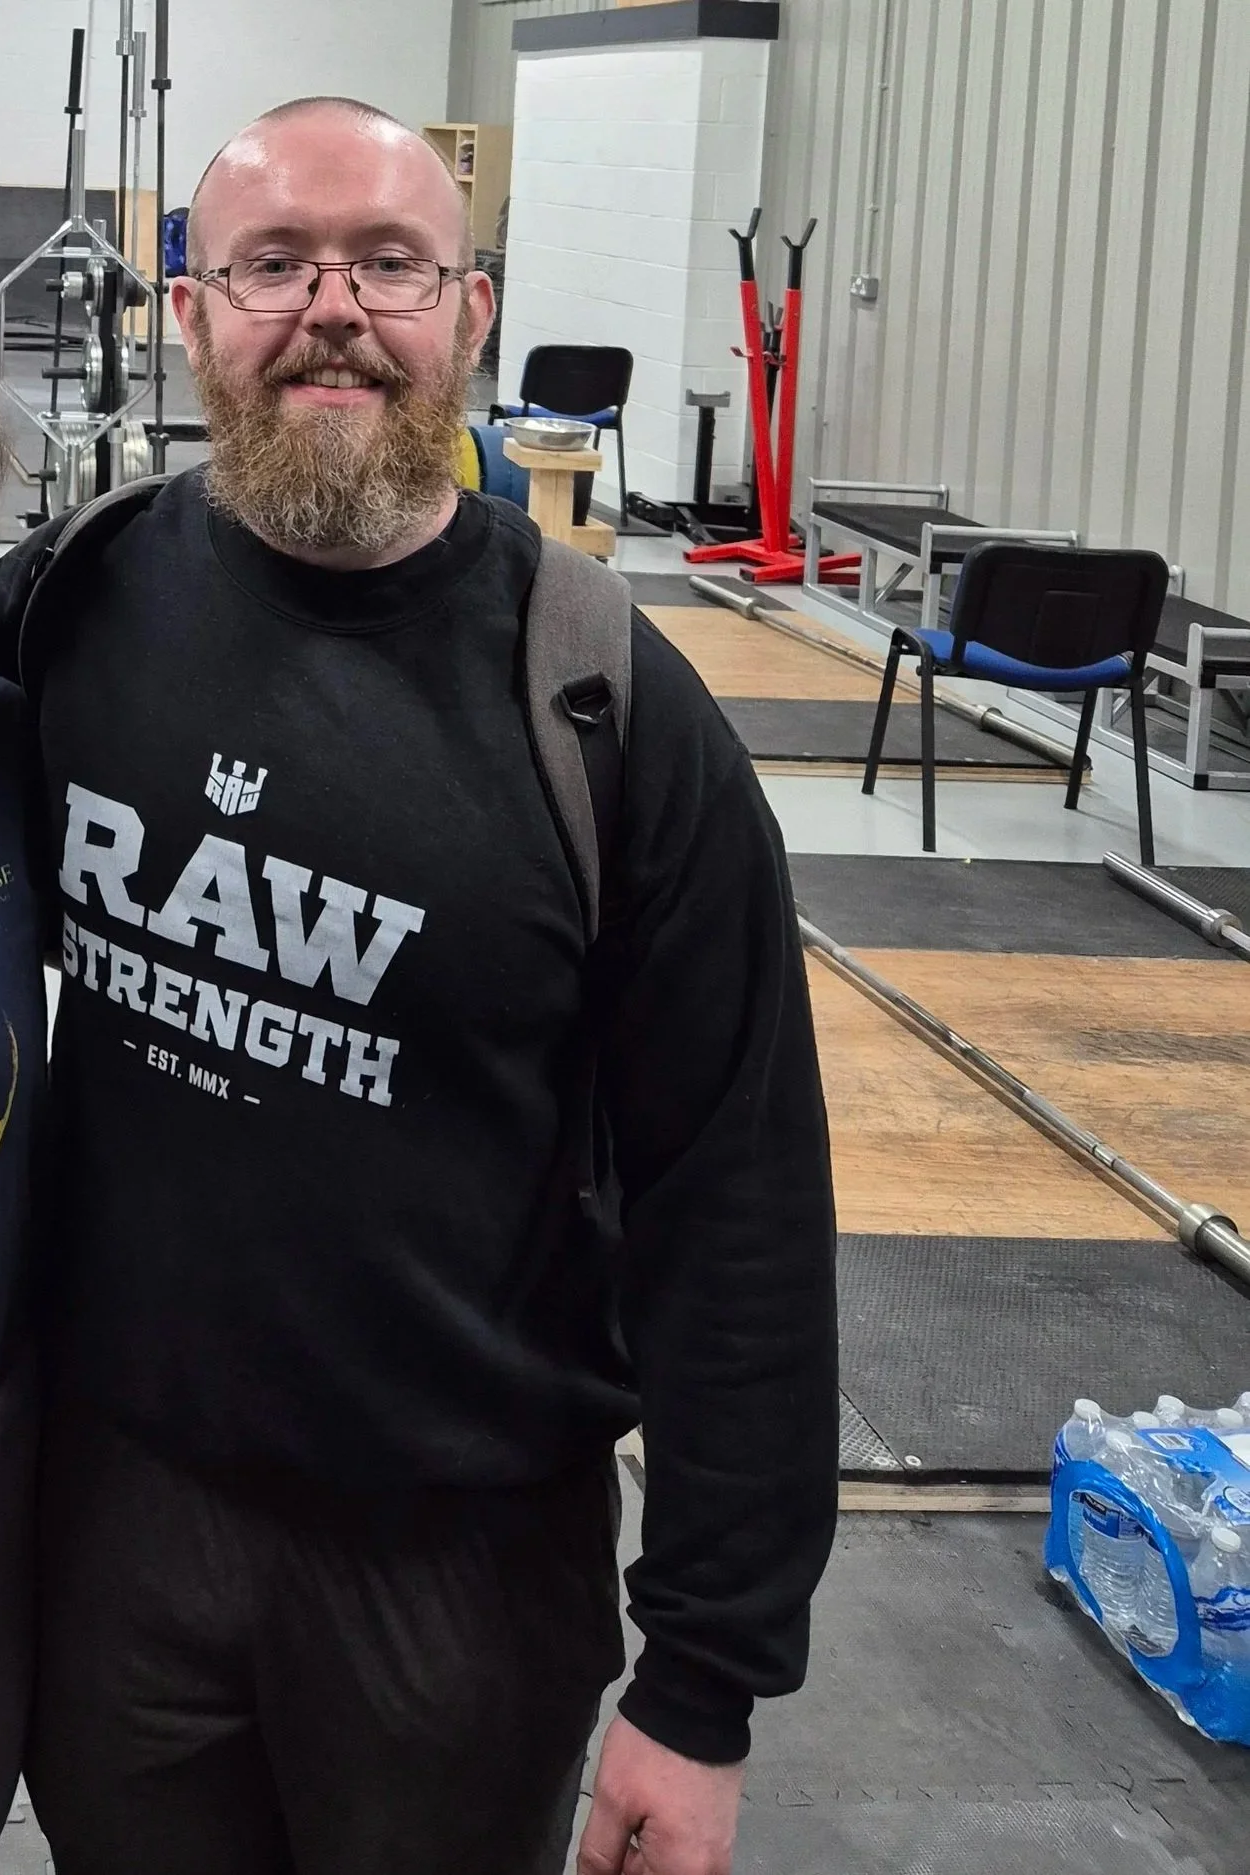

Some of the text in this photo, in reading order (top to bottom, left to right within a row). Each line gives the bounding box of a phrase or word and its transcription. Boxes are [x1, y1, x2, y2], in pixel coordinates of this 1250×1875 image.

[59, 781, 426, 1006] RAW
[63, 911, 401, 1107] STRENGTH
[147, 1044, 230, 1100] EST. MMX
